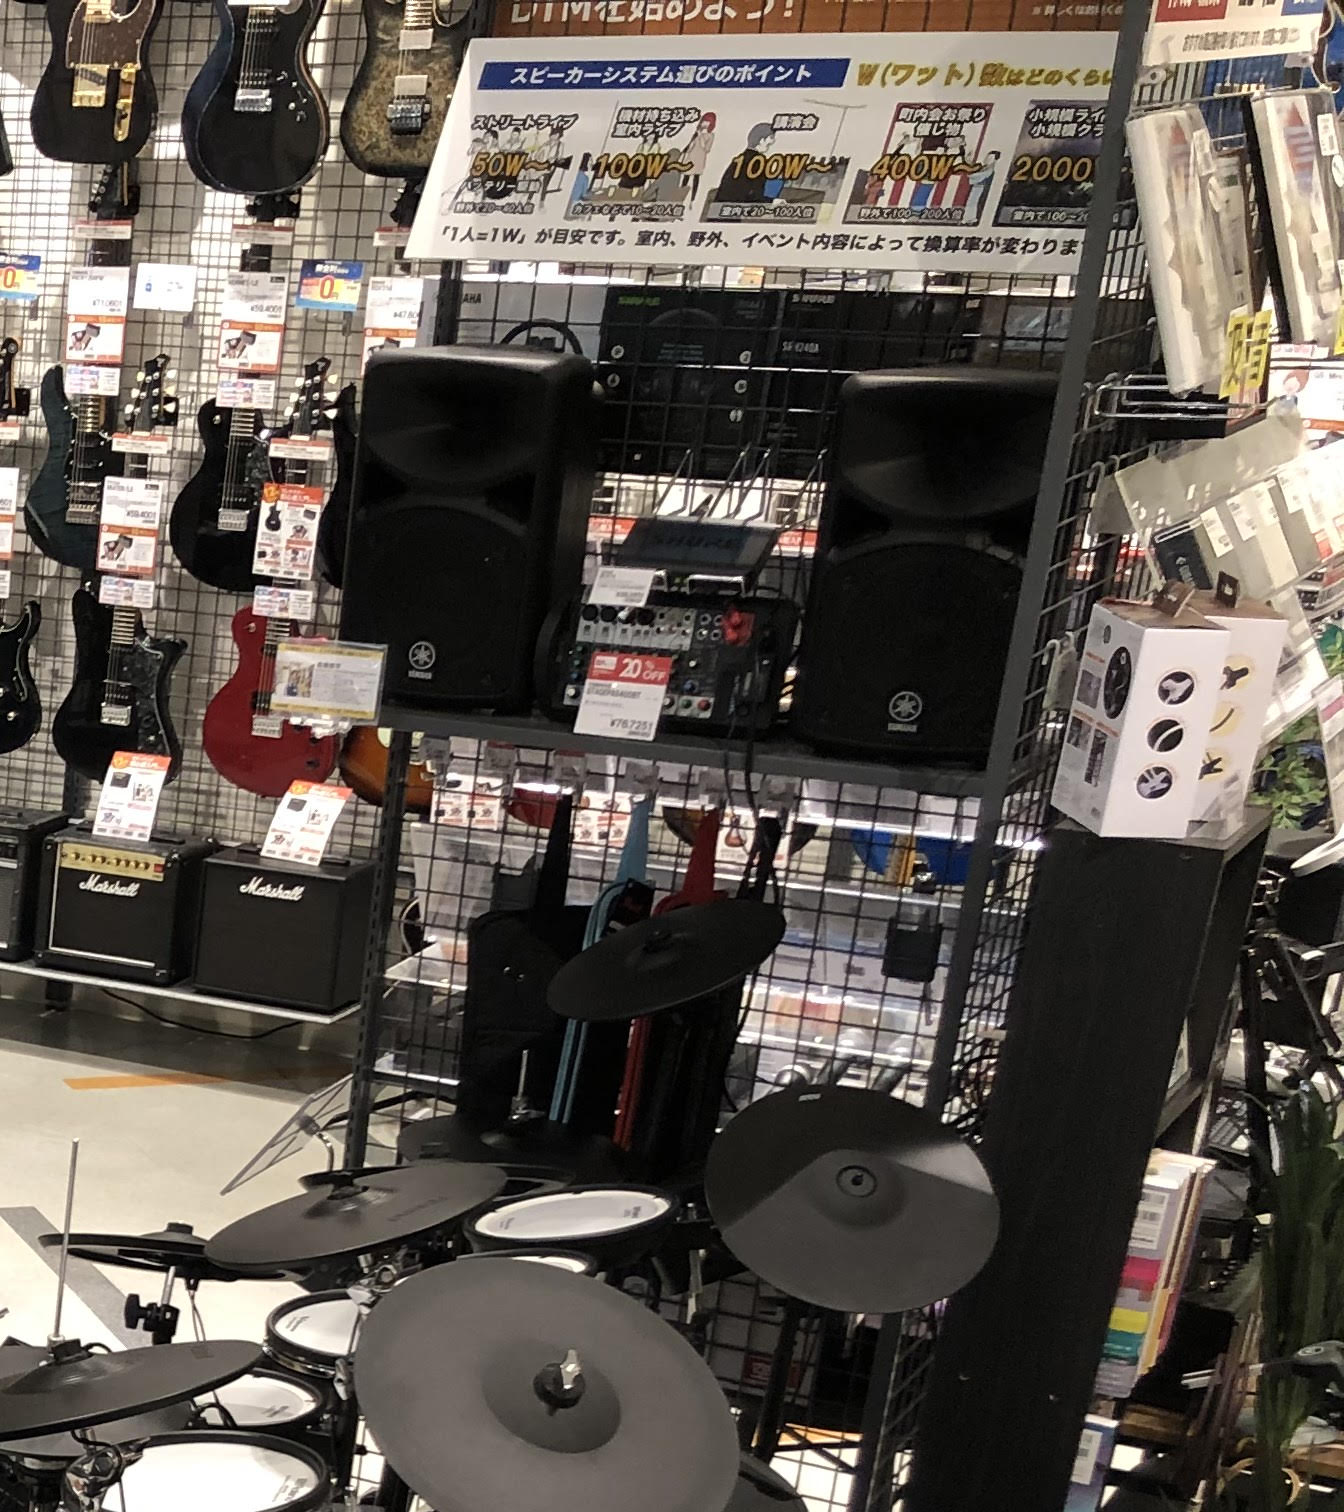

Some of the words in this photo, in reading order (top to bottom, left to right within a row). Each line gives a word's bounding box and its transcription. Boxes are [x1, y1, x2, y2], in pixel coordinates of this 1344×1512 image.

[510, 63, 812, 85] スピーカーシステム選びのポイント
[472, 113, 579, 130] ストリートライブ
[620, 657, 643, 679] 20
[643, 668, 667, 683] OFF
[79, 873, 141, 898] Marshall
[240, 876, 306, 901] Marshall
